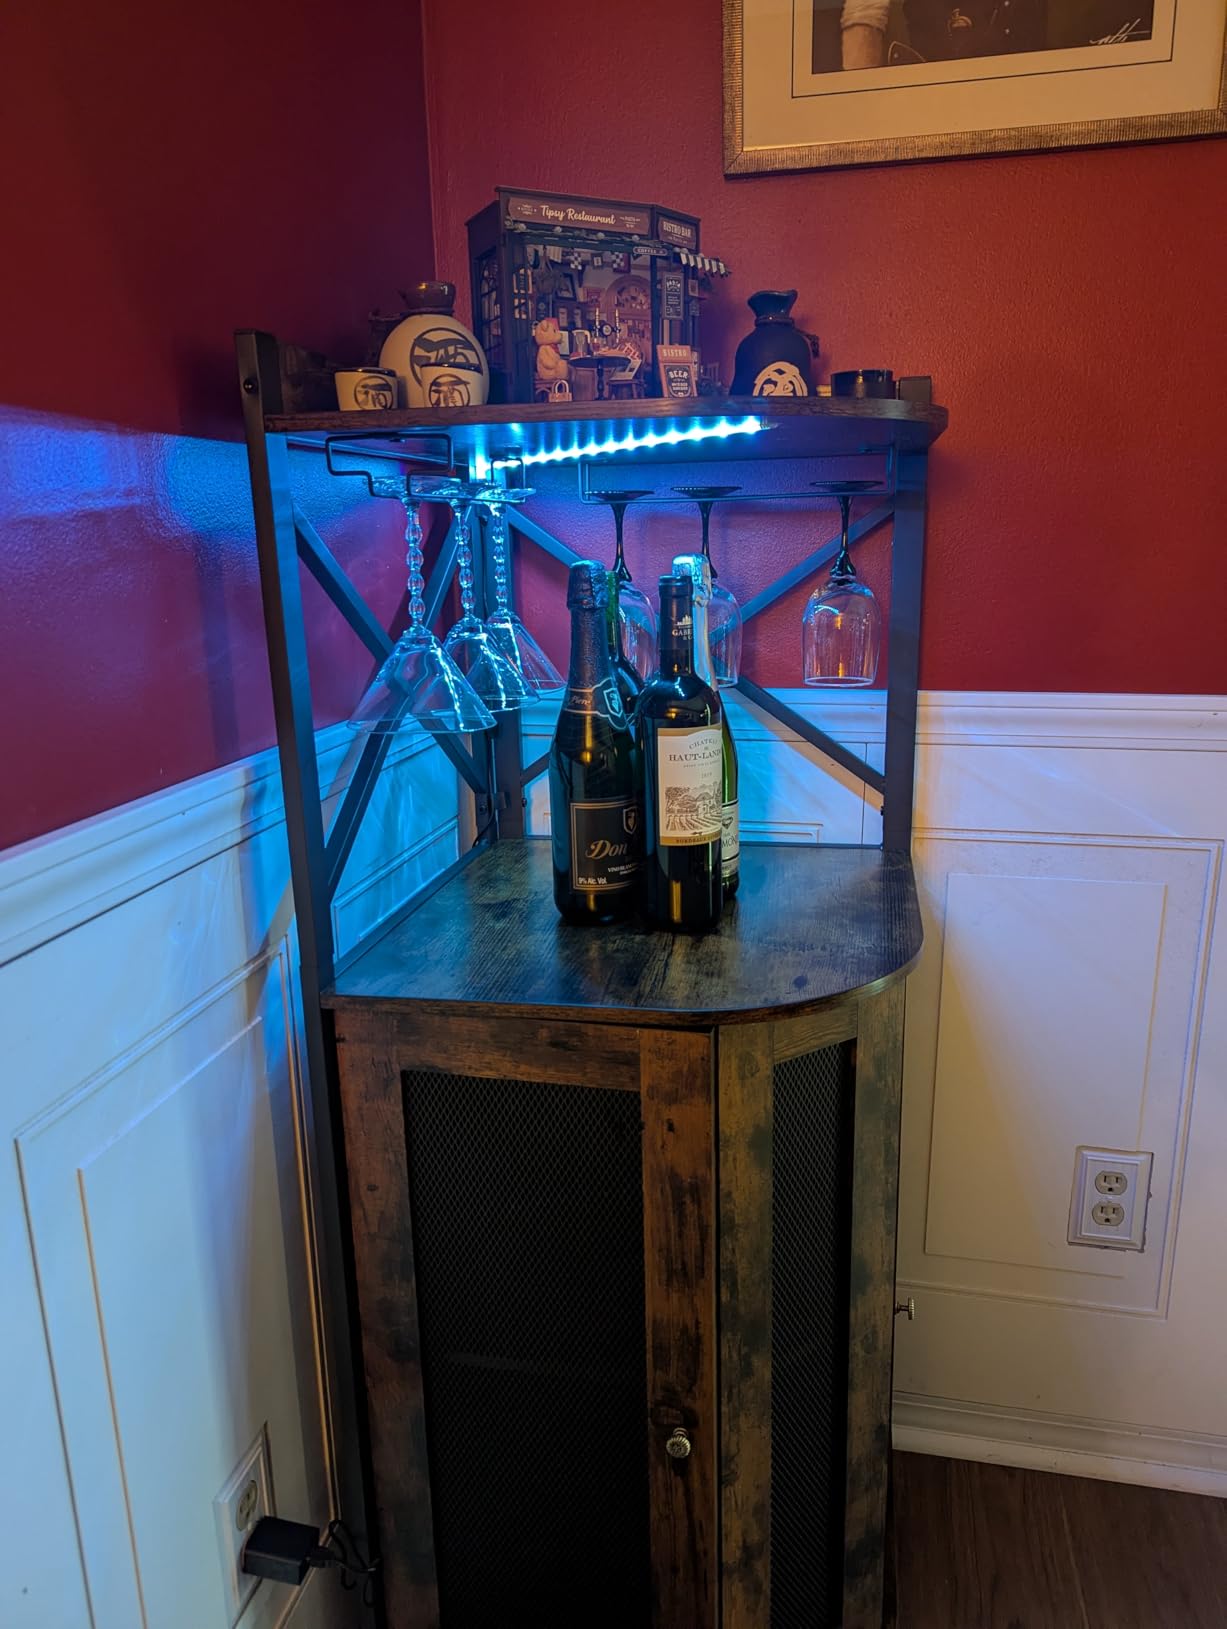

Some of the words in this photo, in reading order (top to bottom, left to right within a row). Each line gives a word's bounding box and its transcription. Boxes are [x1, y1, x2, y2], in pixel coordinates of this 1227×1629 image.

[539, 205, 565, 221] Tipsy
[566, 208, 616, 225] Restaurant
[662, 220, 681, 236] BISTRO
[662, 348, 687, 357] BISTRO
[668, 370, 688, 380] BEER
